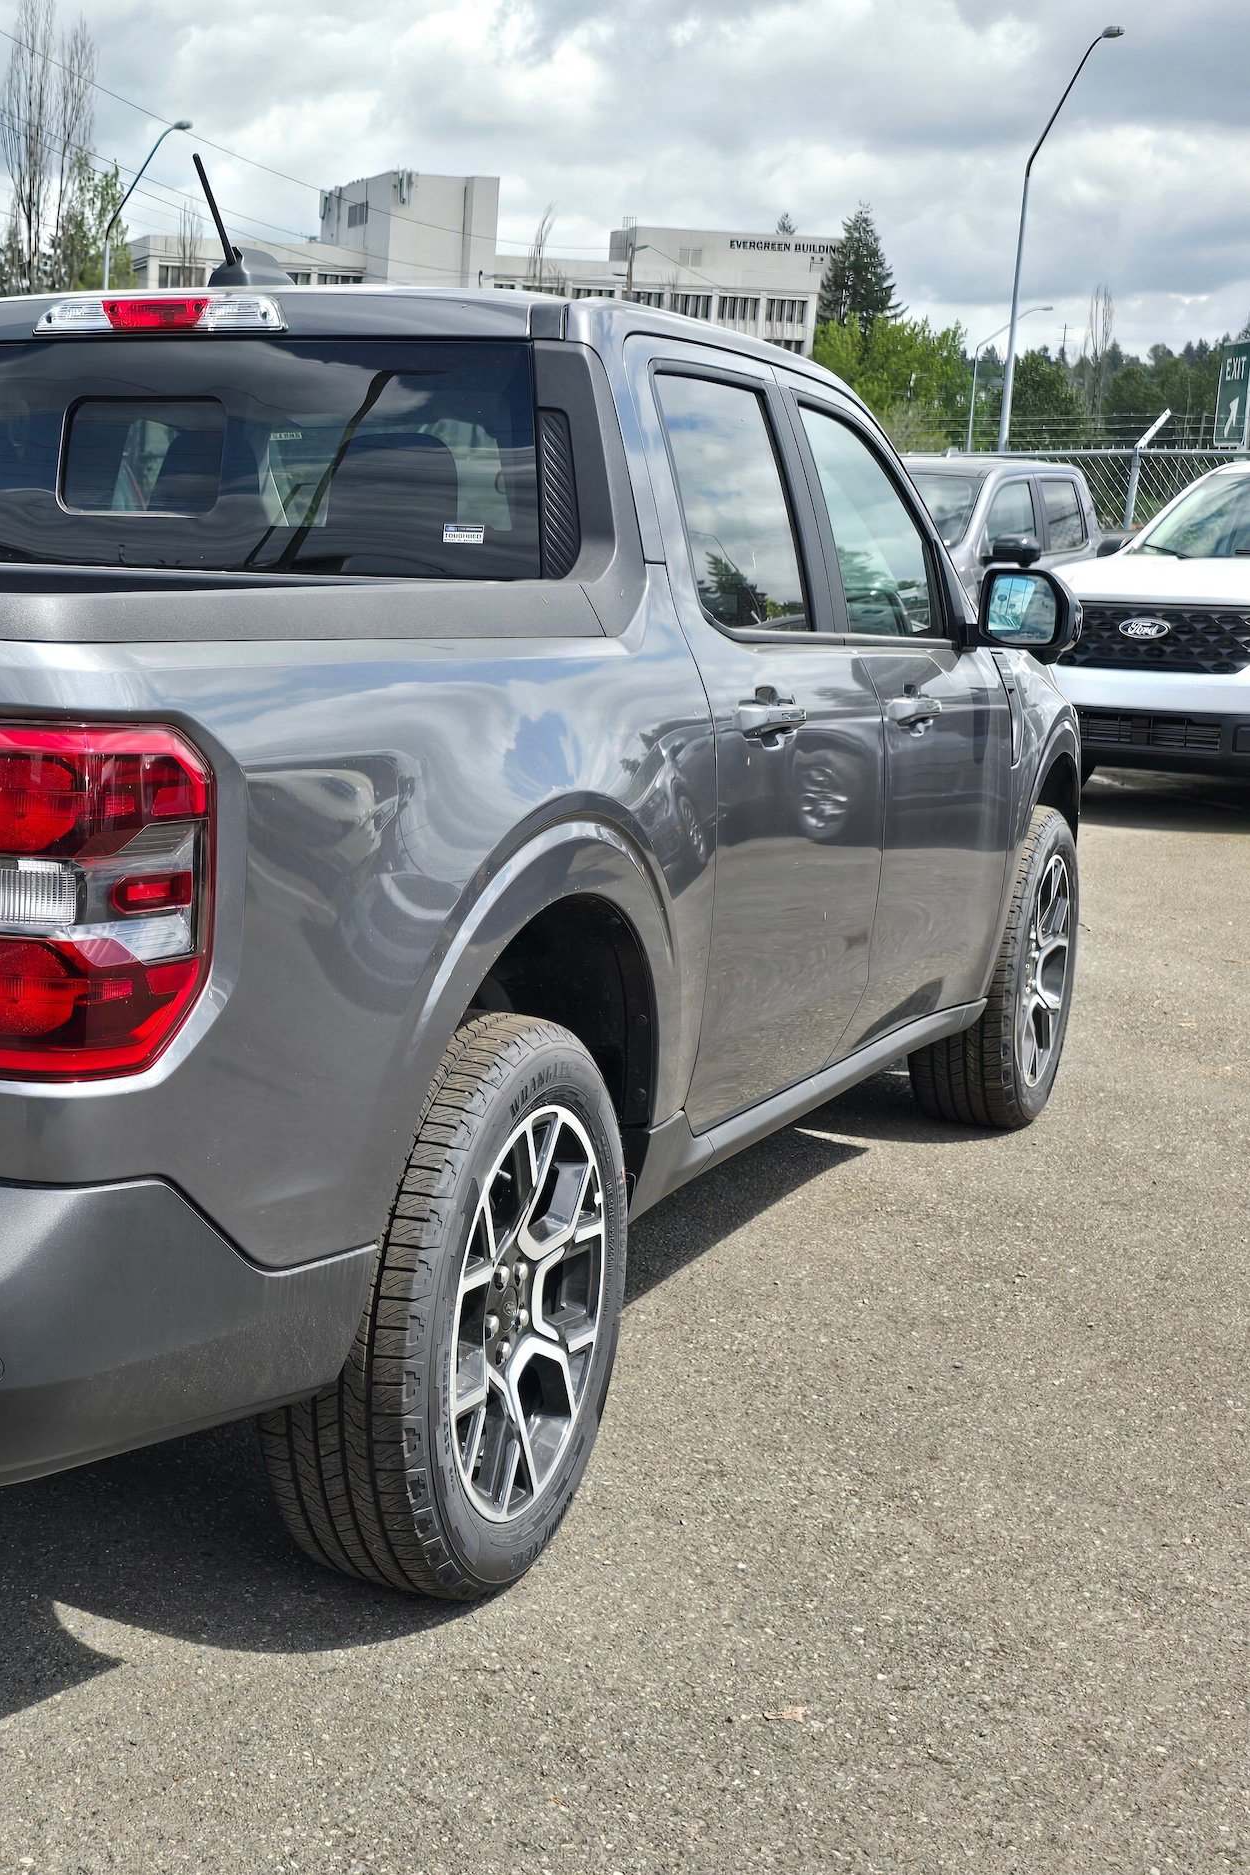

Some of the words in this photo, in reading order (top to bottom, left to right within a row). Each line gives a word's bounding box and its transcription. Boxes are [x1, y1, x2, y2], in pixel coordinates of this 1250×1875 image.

[729, 239, 791, 252] EVERGREEN
[1225, 356, 1247, 381] EXIT
[1127, 621, 1160, 636] Ford
